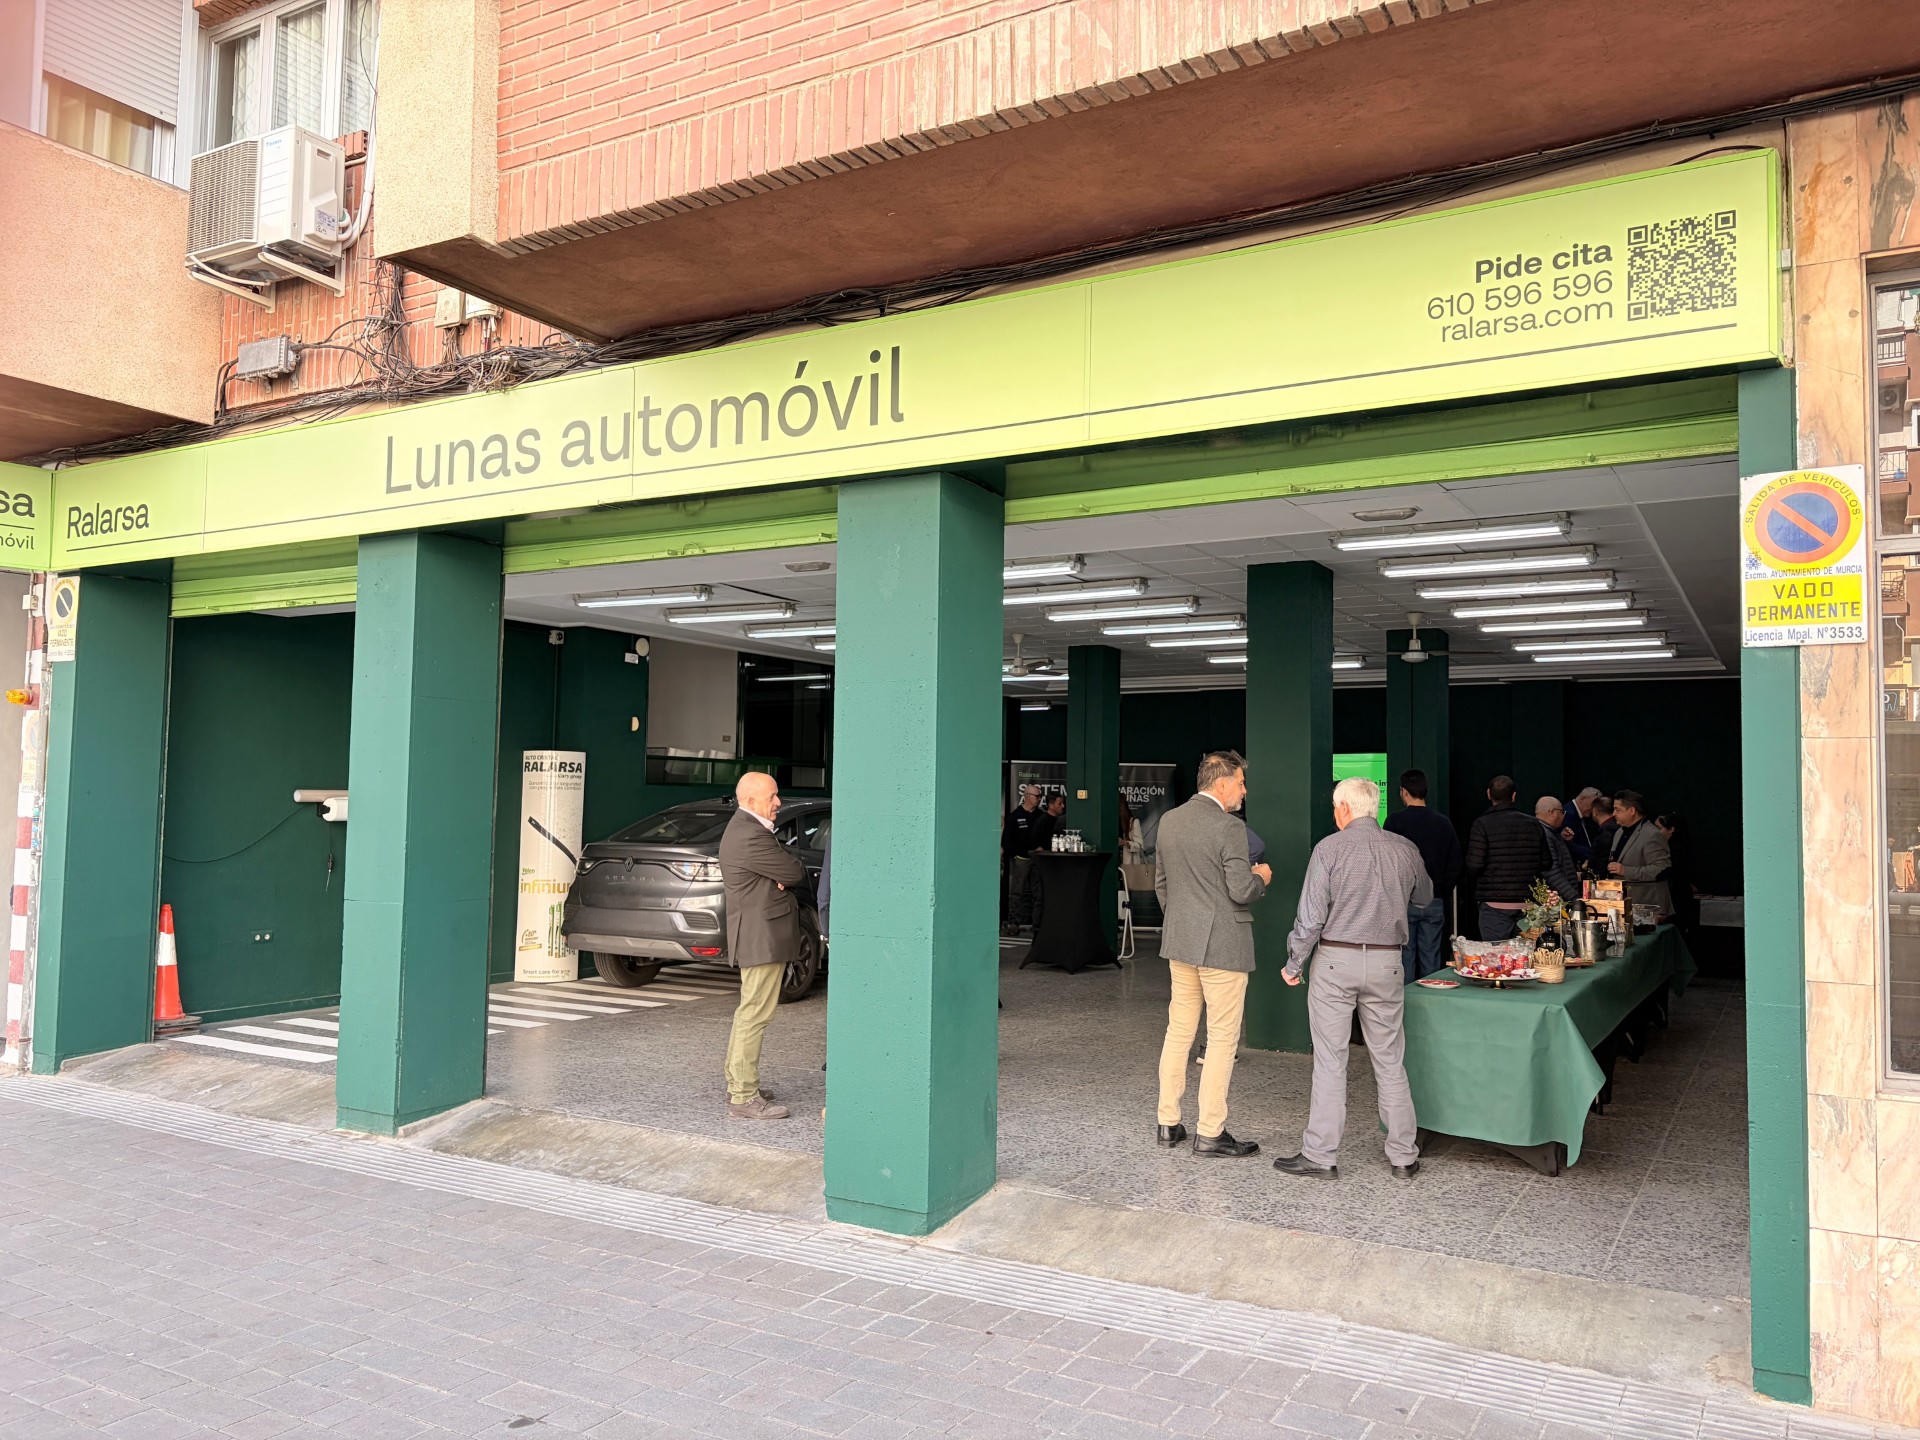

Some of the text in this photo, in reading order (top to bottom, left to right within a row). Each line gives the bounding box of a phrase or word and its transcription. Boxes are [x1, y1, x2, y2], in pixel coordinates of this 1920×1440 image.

[1475, 243, 1613, 283] Pide cita
[1427, 269, 1613, 320] 610 596 596
[1441, 301, 1613, 343] ralarsa.com
[385, 345, 905, 495] Lunas automóvil
[1745, 473, 1861, 523] SALIDA DE VEHICULOS
[67, 502, 150, 539] Ralarsa
[1771, 566, 1821, 578] AYUNTAMIENTO
[1823, 566, 1833, 575] DE
[1836, 564, 1863, 574] MURCIA
[1773, 581, 1834, 599] VADO
[1747, 601, 1861, 622] PERMANENTE
[1745, 629, 1783, 641] Licencia
[1787, 628, 1813, 641] Mpal.
